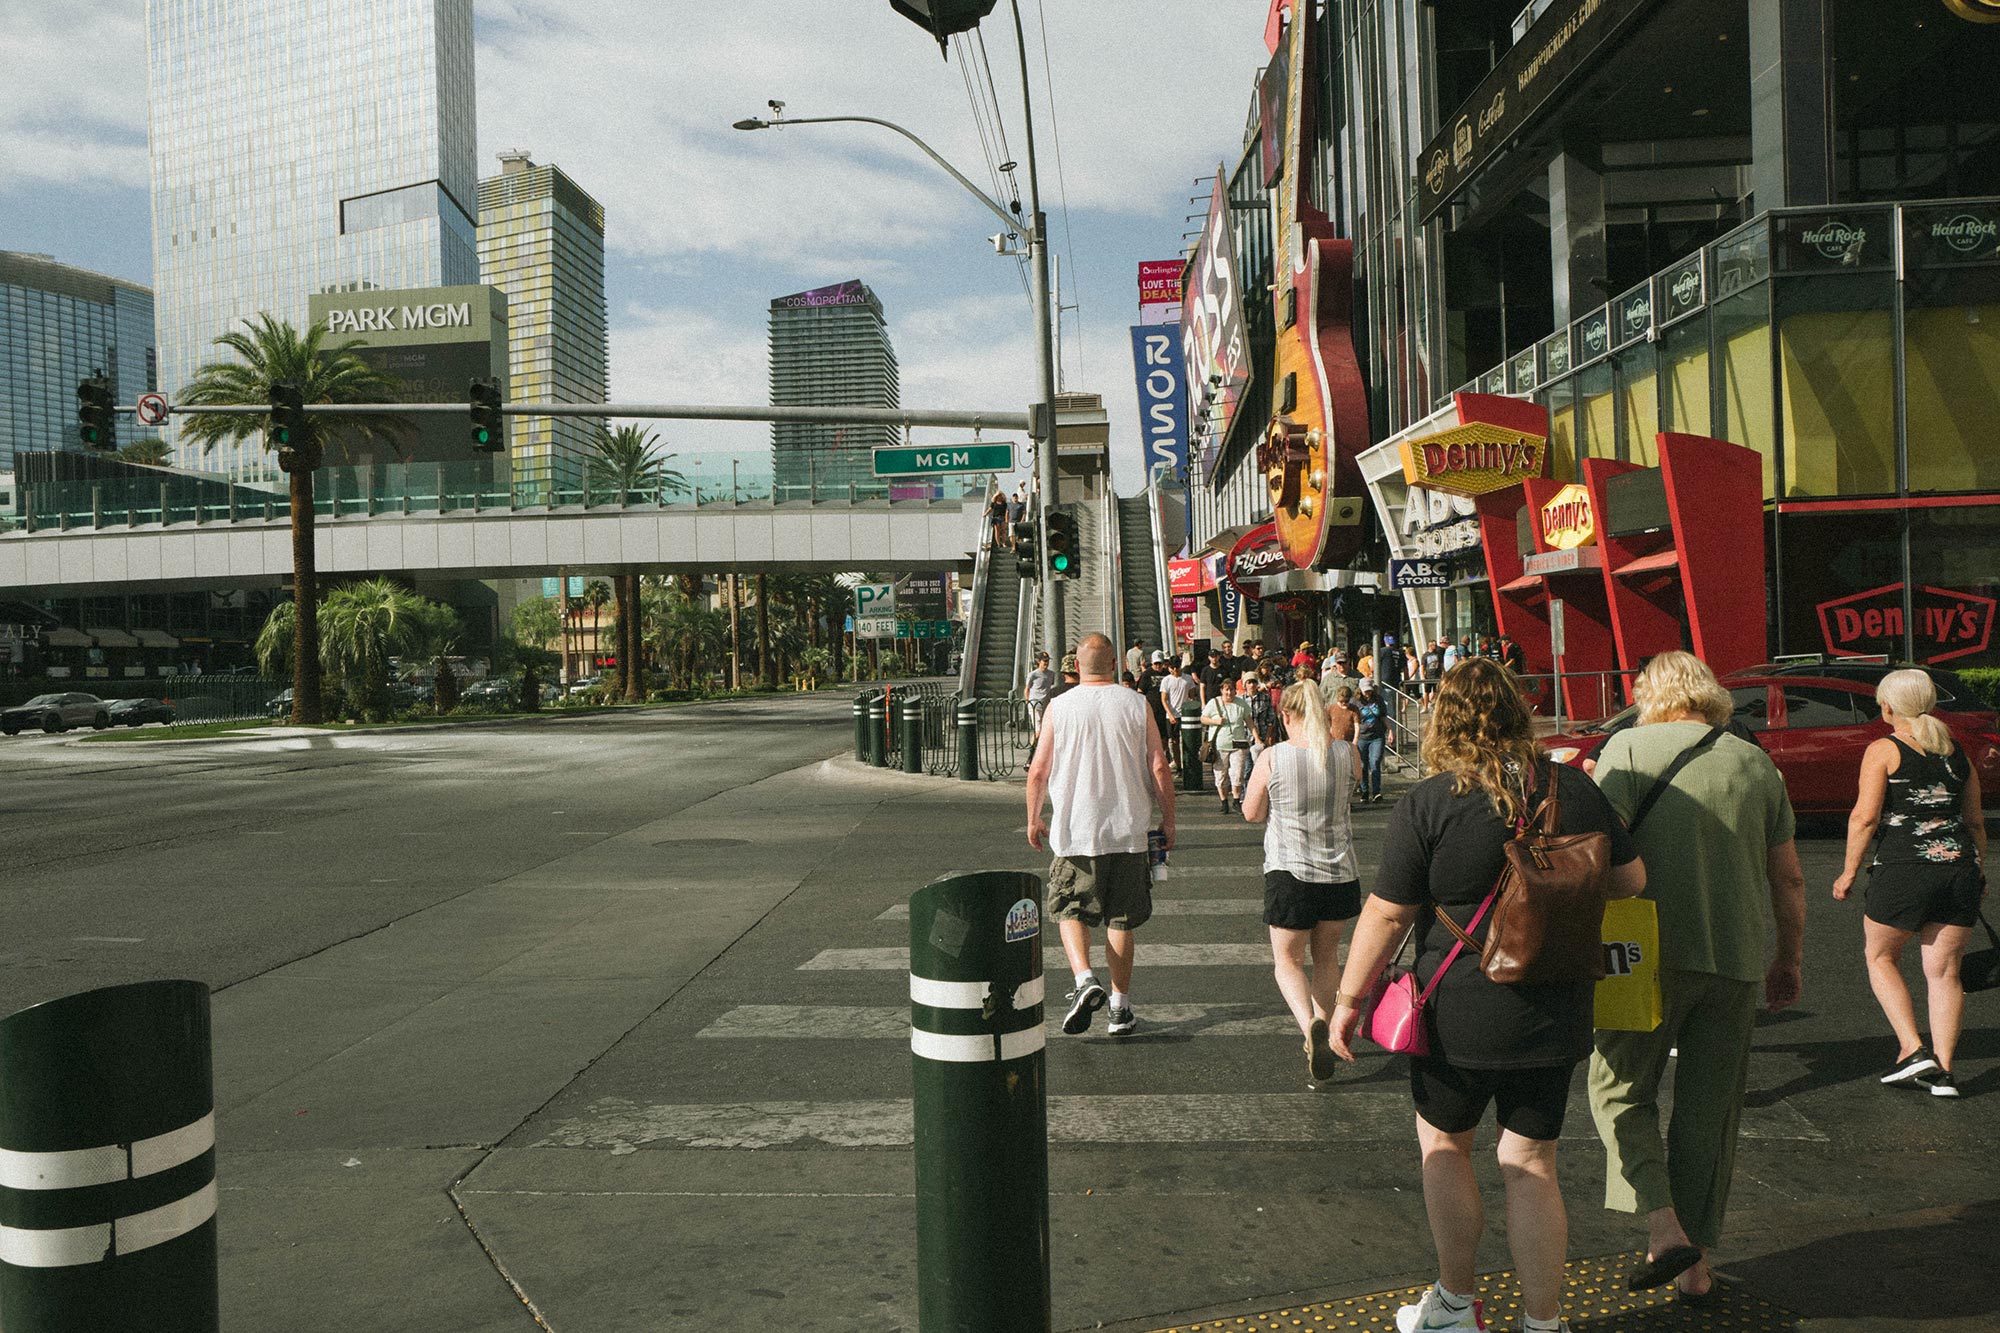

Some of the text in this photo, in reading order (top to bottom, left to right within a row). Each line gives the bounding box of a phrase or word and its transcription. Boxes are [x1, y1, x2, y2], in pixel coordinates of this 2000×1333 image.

[1802, 227, 1866, 244] Hard Rock
[1931, 221, 1997, 237] Hard Rock
[1142, 280, 1164, 290] LOVE
[786, 294, 865, 307] COSMOPOLITAN
[1143, 289, 1182, 300] DEALS
[328, 302, 471, 333] PARK MGM
[1184, 211, 1232, 416] ROSS
[1145, 334, 1178, 468] ROSS
[916, 452, 969, 467] MGM
[1420, 438, 1537, 477] Denny's
[1543, 496, 1588, 536] Denny's
[1232, 551, 1284, 574] FlyOve
[1396, 562, 1448, 577] ABC
[1397, 576, 1447, 585] STORES
[859, 623, 871, 633] 140
[876, 621, 894, 632] FEET
[1833, 603, 1979, 643] Denny's
